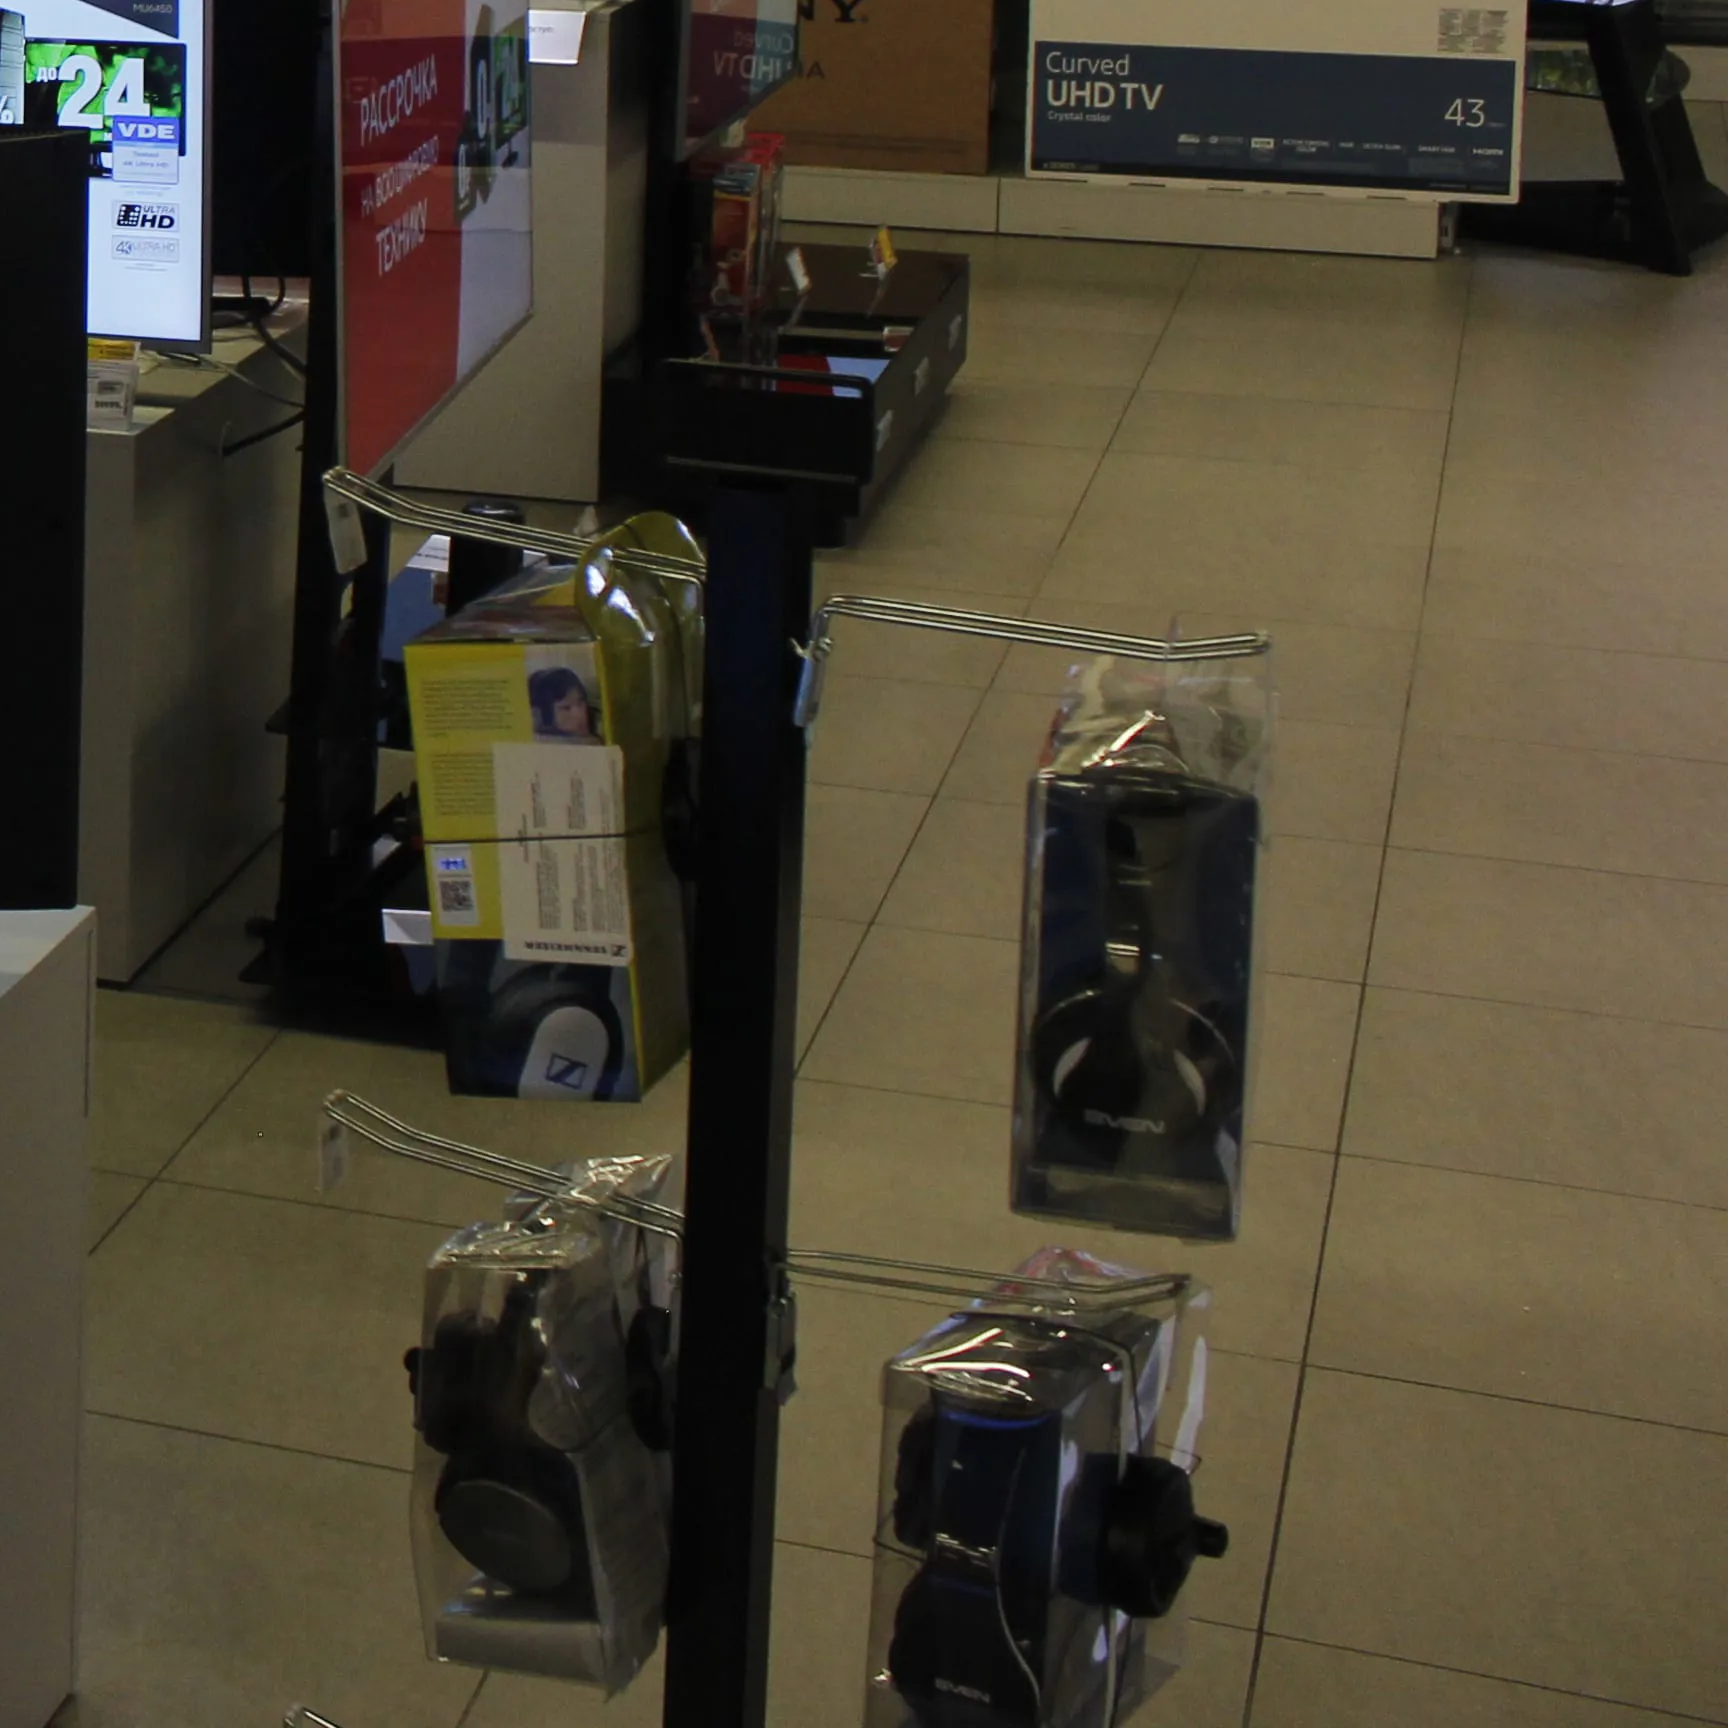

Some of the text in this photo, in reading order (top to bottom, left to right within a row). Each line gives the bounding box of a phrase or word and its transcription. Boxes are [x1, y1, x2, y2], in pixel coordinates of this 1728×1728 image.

[1045, 51, 1131, 76] Curved
[56, 54, 151, 130] 24
[358, 53, 439, 147] РАССРОЧКА
[1443, 98, 1486, 128] 43
[118, 123, 175, 139] VDE
[140, 215, 175, 229] HD
[143, 205, 176, 214] ULTRA
[375, 196, 429, 277] ТЕХНИКУ
[1083, 1108, 1166, 1135] SVEN
[934, 1676, 992, 1704] SVEN
